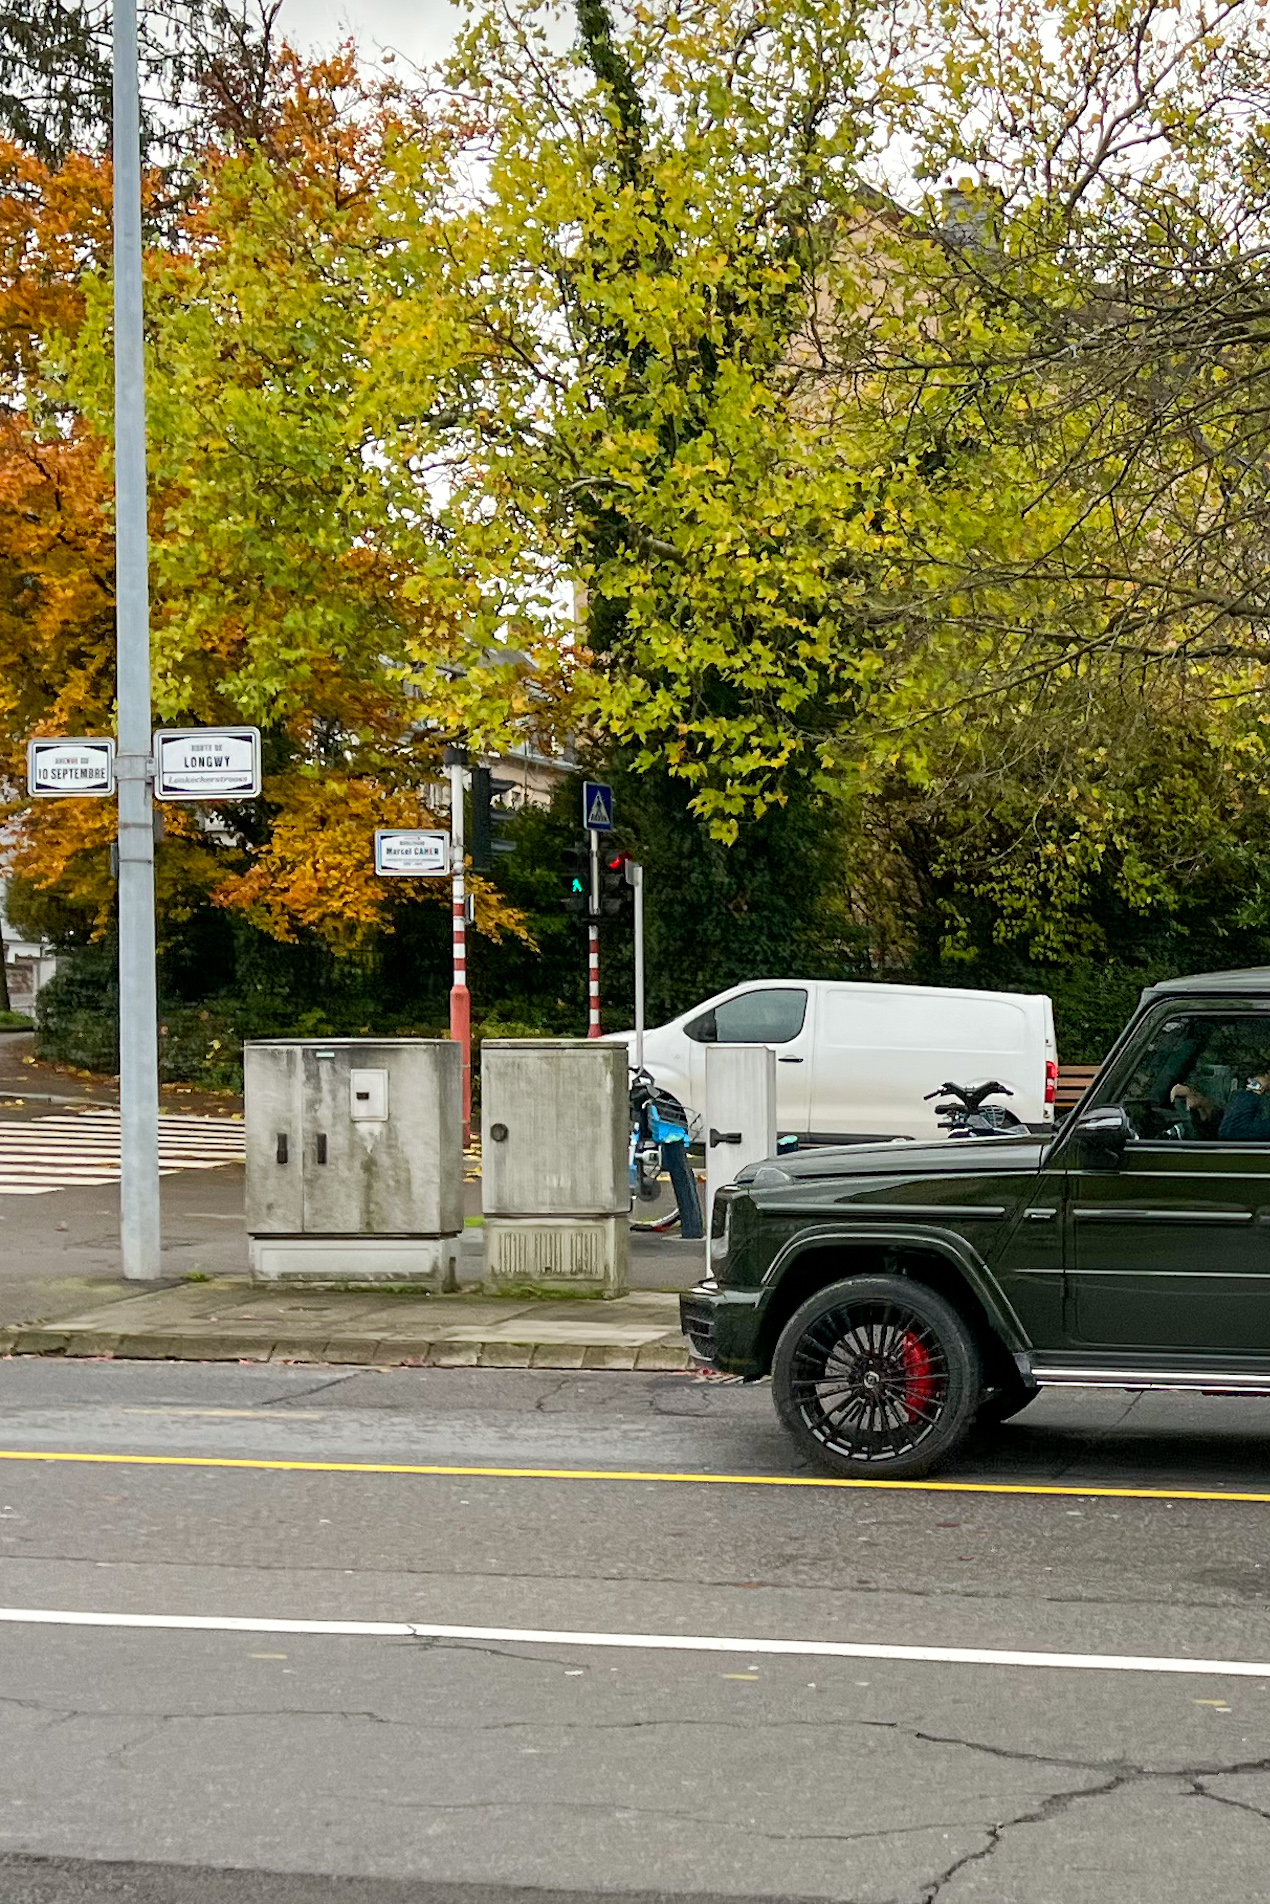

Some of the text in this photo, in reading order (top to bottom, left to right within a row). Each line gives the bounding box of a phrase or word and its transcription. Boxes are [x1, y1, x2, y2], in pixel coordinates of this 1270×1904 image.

[184, 756, 230, 768] LONGWY
[38, 768, 106, 780] 10 SEPTEMBRE
[386, 847, 412, 855] Marcel
